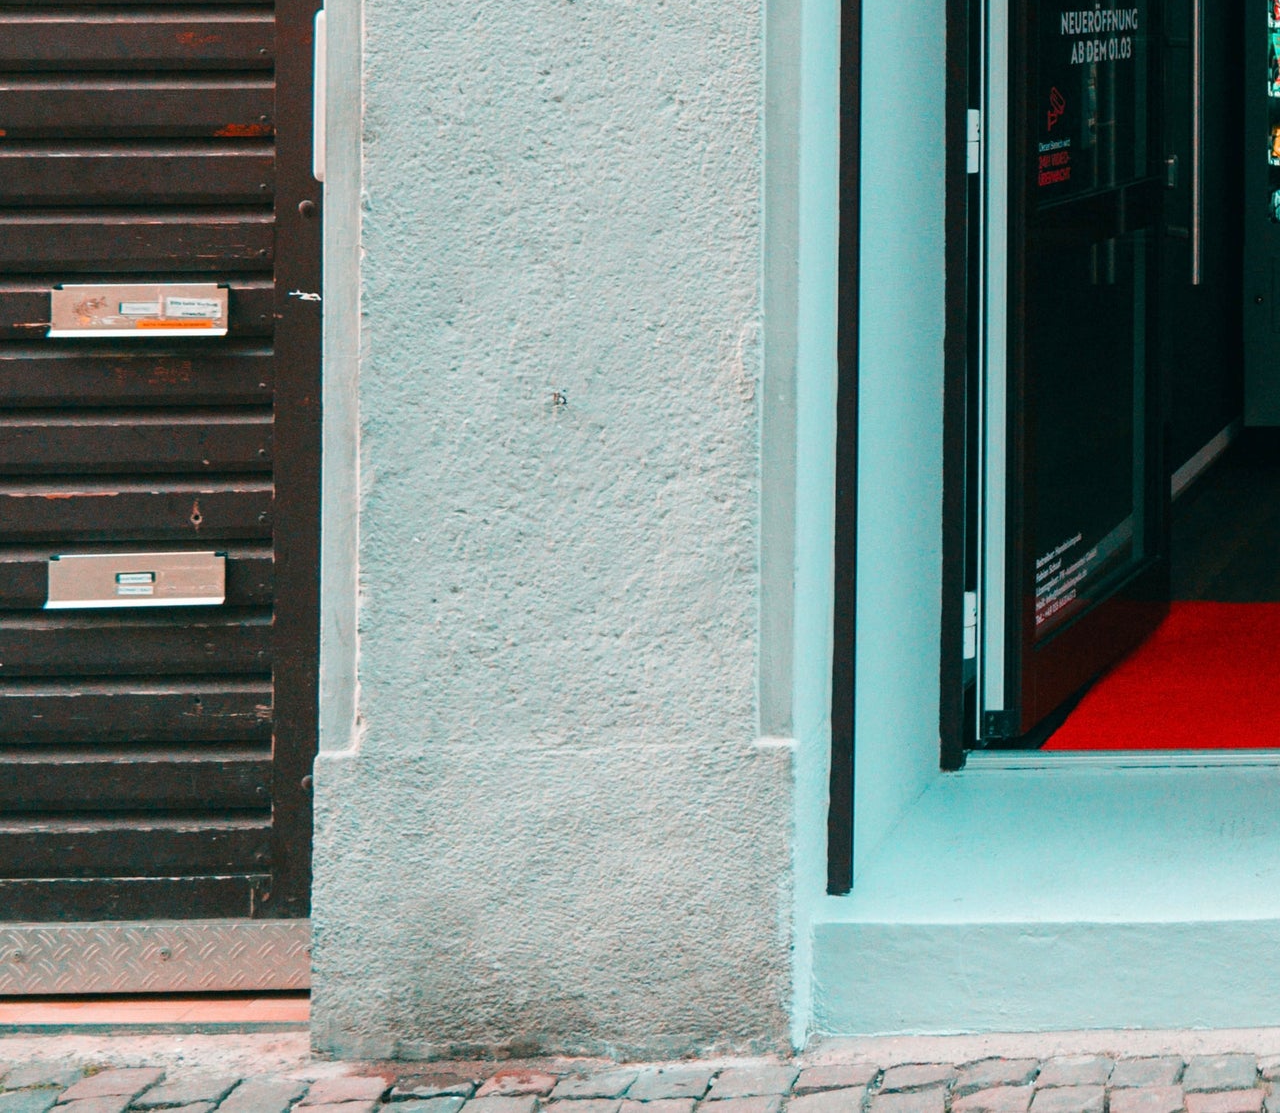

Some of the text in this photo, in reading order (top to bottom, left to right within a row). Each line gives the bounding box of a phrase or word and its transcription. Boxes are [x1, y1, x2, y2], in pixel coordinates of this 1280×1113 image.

[1061, 4, 1138, 35] NEUERÖFFNUNG
[1071, 36, 1132, 64] AB DEM 01.03
